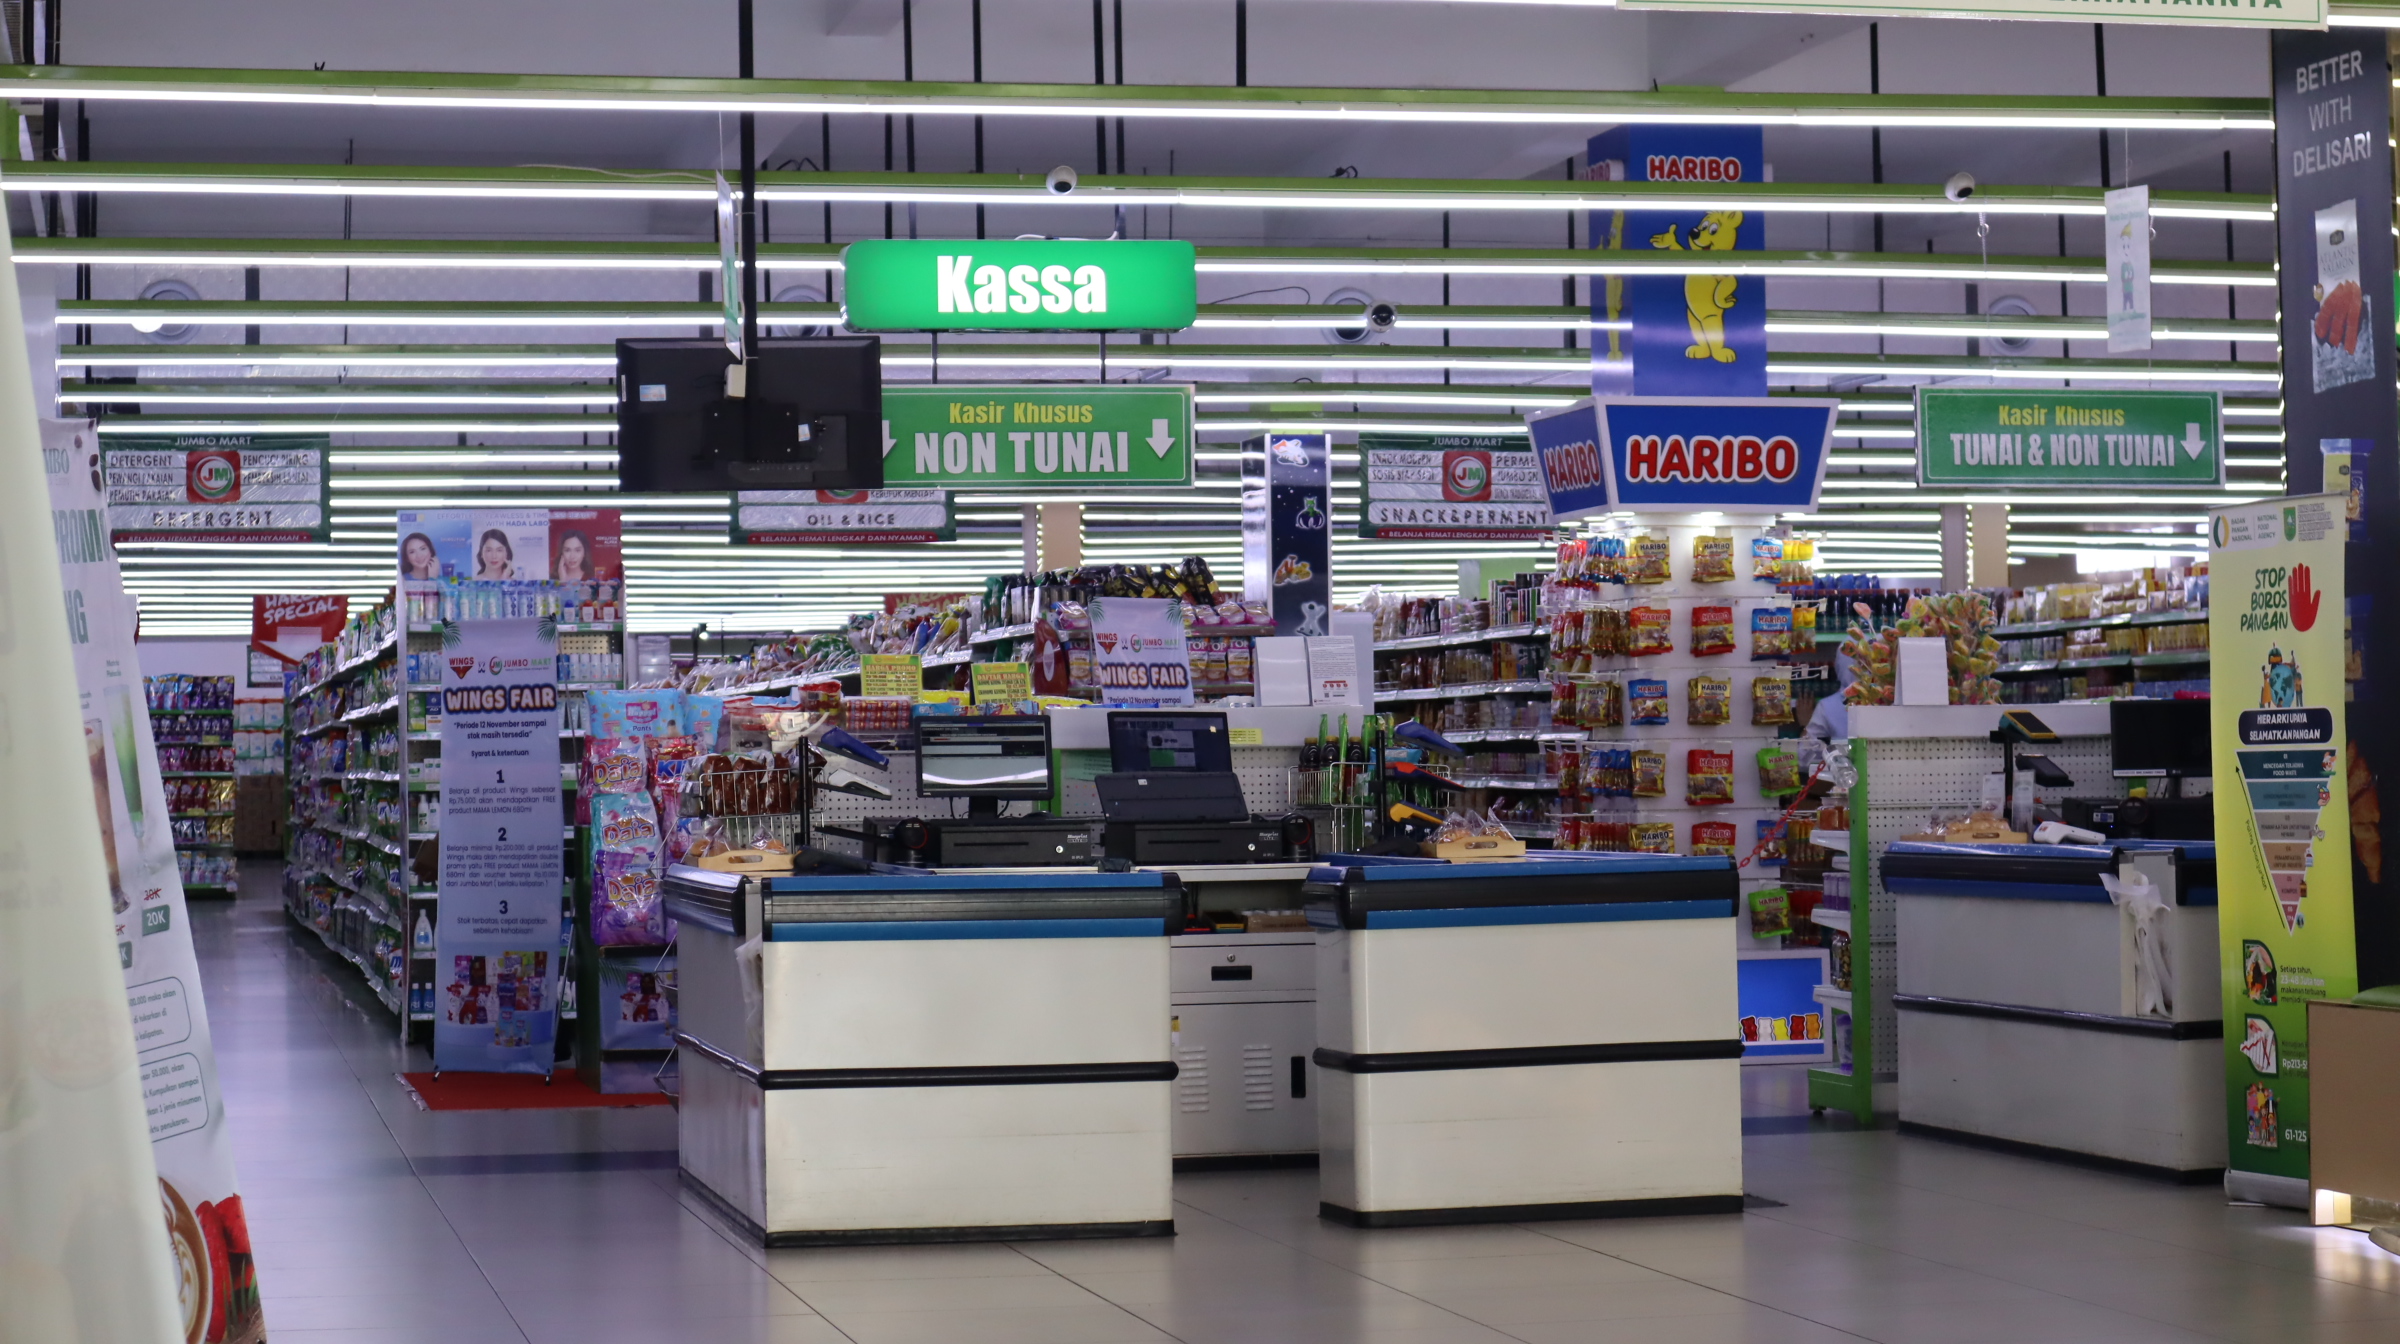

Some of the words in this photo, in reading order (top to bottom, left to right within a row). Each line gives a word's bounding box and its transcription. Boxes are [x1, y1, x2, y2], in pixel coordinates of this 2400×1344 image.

[2296, 49, 2363, 94] BETTER
[2309, 95, 2353, 131] WITH
[2293, 132, 2372, 177] DELISARI
[1647, 155, 1741, 182] HARIBO
[936, 255, 1107, 313] Kassa
[949, 401, 1005, 424] Kasir
[1013, 402, 1093, 424] Khusus
[1999, 405, 2048, 426] Kasir
[2055, 406, 2125, 427] Khusus
[175, 436, 215, 446] JUMBO
[219, 436, 252, 446] MART
[1432, 437, 1470, 446] JUMBO
[1472, 437, 1503, 446] MART
[914, 432, 996, 474] NON
[1008, 431, 1129, 473] TUNAI
[1950, 433, 2022, 466] TUNAI
[2028, 433, 2045, 466] &
[2050, 434, 2099, 466] NON
[2104, 434, 2175, 466] TUNAI
[110, 455, 173, 467] DETERGENT
[1626, 434, 1798, 483] HARIBO
[1544, 439, 1601, 493] HARIBO
[203, 468, 229, 481] JM
[1457, 467, 1481, 481] JM
[152, 511, 273, 528] DETERGENT
[807, 514, 833, 526] OIL
[841, 514, 850, 526] &
[858, 513, 895, 525] RICE
[128, 534, 166, 542] BELANJA
[760, 535, 797, 543] BELANJA
[798, 535, 828, 543] HEMAT
[827, 535, 866, 543] LENGKAP
[867, 534, 886, 542] DAN
[888, 534, 925, 542] NYAMAN
[2258, 532, 2276, 540] AGENCY
[1640, 543, 1667, 551] HARIBO
[1704, 542, 1730, 550] HARIBO
[2254, 566, 2286, 590] STOP
[2250, 589, 2288, 611] BOROS
[263, 598, 339, 625] SPECIAL
[1758, 615, 1788, 624] HARIBO
[2240, 611, 2289, 633] PANGAN
[1096, 632, 1118, 641] WINGS
[1142, 639, 1163, 647] JUMBO
[1188, 641, 1207, 650] TOP
[449, 657, 475, 666] WINGS
[503, 659, 529, 668] JUMBO
[1101, 664, 1148, 689] WINGS
[1149, 664, 1188, 689] FAIR
[1637, 684, 1665, 692] HARIBO
[1701, 684, 1728, 692] HARIBO
[1761, 684, 1787, 692] HARIBO
[444, 686, 506, 714] WINGS
[508, 684, 557, 712] FAIR
[1134, 696, 1161, 704] November
[1162, 696, 1182, 705] sampai
[480, 721, 486, 729] 12
[487, 720, 520, 728] November
[521, 719, 547, 729] sampai
[2257, 713, 2290, 725] HIERARKI
[2289, 713, 2308, 723] UPAYA
[467, 731, 480, 740] stok
[481, 731, 501, 739] masih
[2249, 729, 2293, 741] SELAMATKAN
[2292, 729, 2321, 740] PANGAN
[471, 750, 491, 759] Syarat
[497, 749, 530, 757] ketentuan
[1638, 757, 1662, 765] HARIBO
[1699, 757, 1730, 767] HARIBO
[496, 769, 505, 784] 1
[593, 758, 643, 786] Daia
[497, 827, 507, 842] 2
[602, 820, 656, 846] Daia
[1641, 831, 1670, 840] HARIBO
[1701, 829, 1732, 839] HARIBO
[605, 876, 657, 901] Daia
[499, 900, 509, 915] 3
[1758, 896, 1784, 906] HARIBO
[146, 912, 166, 927] 20K
[2280, 965, 2297, 974] Setiap
[2280, 975, 2300, 985] 23-48
[2280, 986, 2304, 995] makanan
[2304, 988, 2327, 997] terbuang
[2285, 1128, 2307, 1143] 61-125
